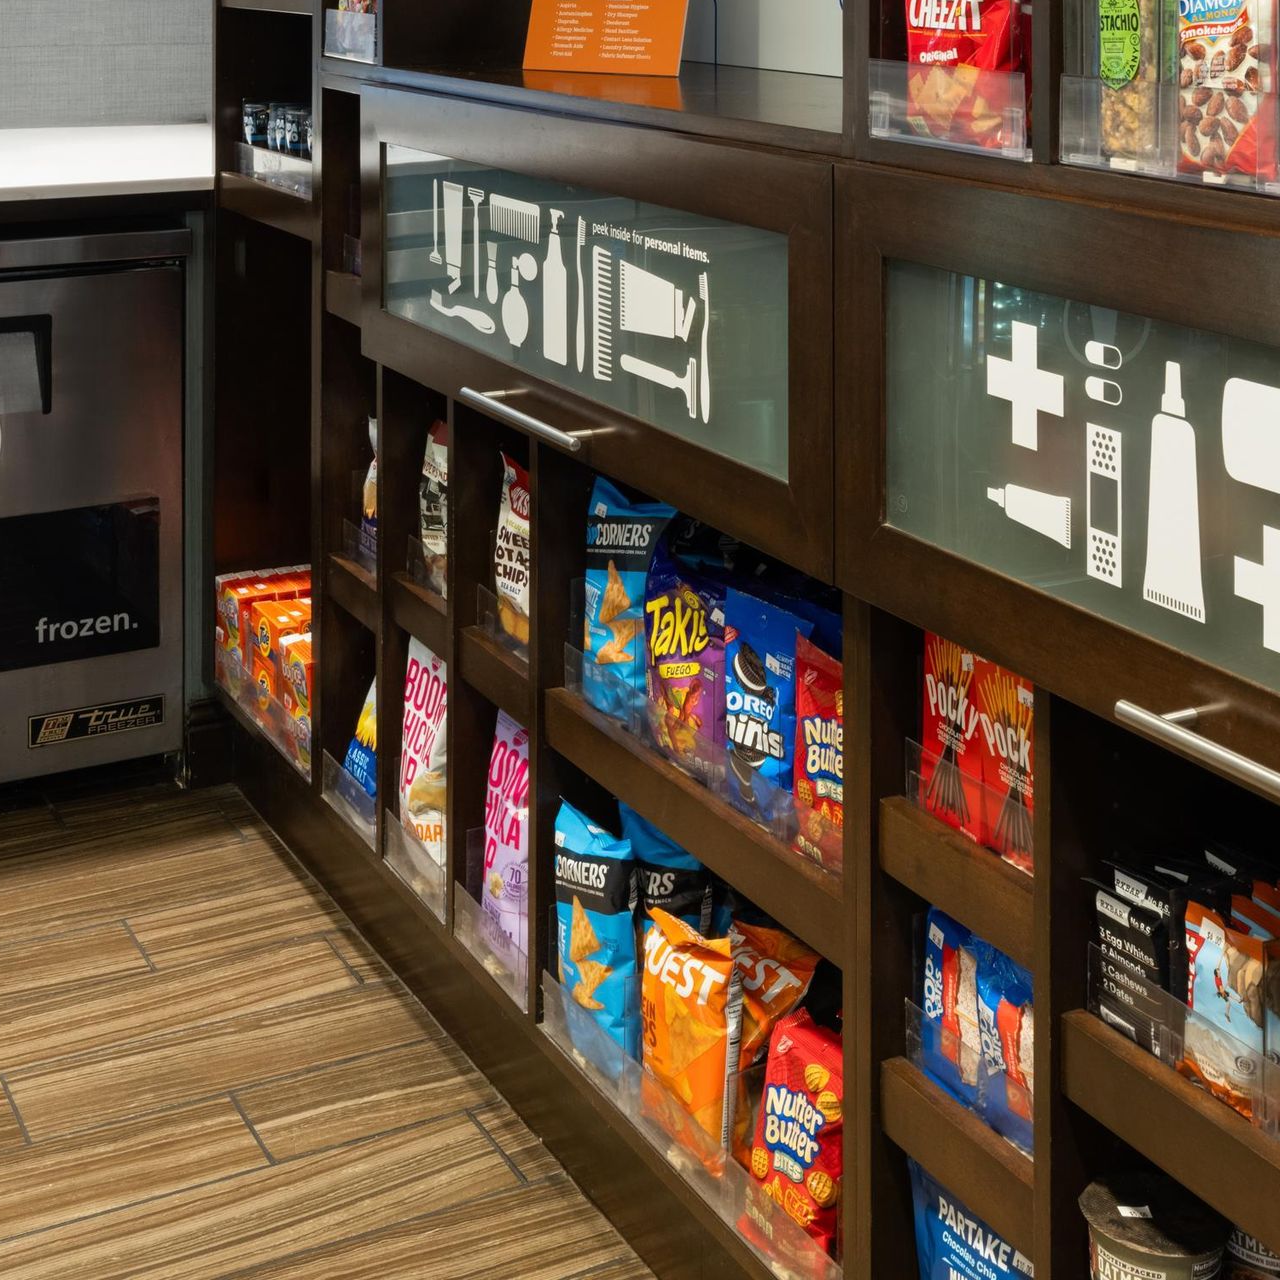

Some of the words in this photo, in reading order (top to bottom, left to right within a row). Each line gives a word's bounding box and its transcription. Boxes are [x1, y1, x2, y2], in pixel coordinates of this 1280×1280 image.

[592, 221, 609, 239] peek
[610, 223, 632, 244] inside
[632, 227, 643, 246] for
[644, 236, 682, 258] personal
[683, 241, 711, 265] items.
[497, 524, 530, 551] SWEE
[35, 612, 139, 644] frozen.
[645, 594, 710, 667] Takis
[665, 664, 692, 677] FUEGO
[78, 704, 156, 727] true
[726, 694, 775, 721] OREO
[88, 715, 156, 735] FREEZER
[804, 718, 843, 754] Nutte
[806, 742, 843, 778] Butte
[1105, 930, 1122, 950] Egg
[1124, 939, 1155, 967] Whites
[1109, 946, 1147, 979] Almonds
[1108, 965, 1149, 997] Cashews
[1109, 982, 1134, 1006] Dates
[766, 1085, 824, 1133] Nutter
[765, 1118, 820, 1168] Butter
[773, 1153, 804, 1183] BITES
[938, 1195, 1011, 1273] PARTAKE
[942, 1230, 976, 1268] Chocolate
